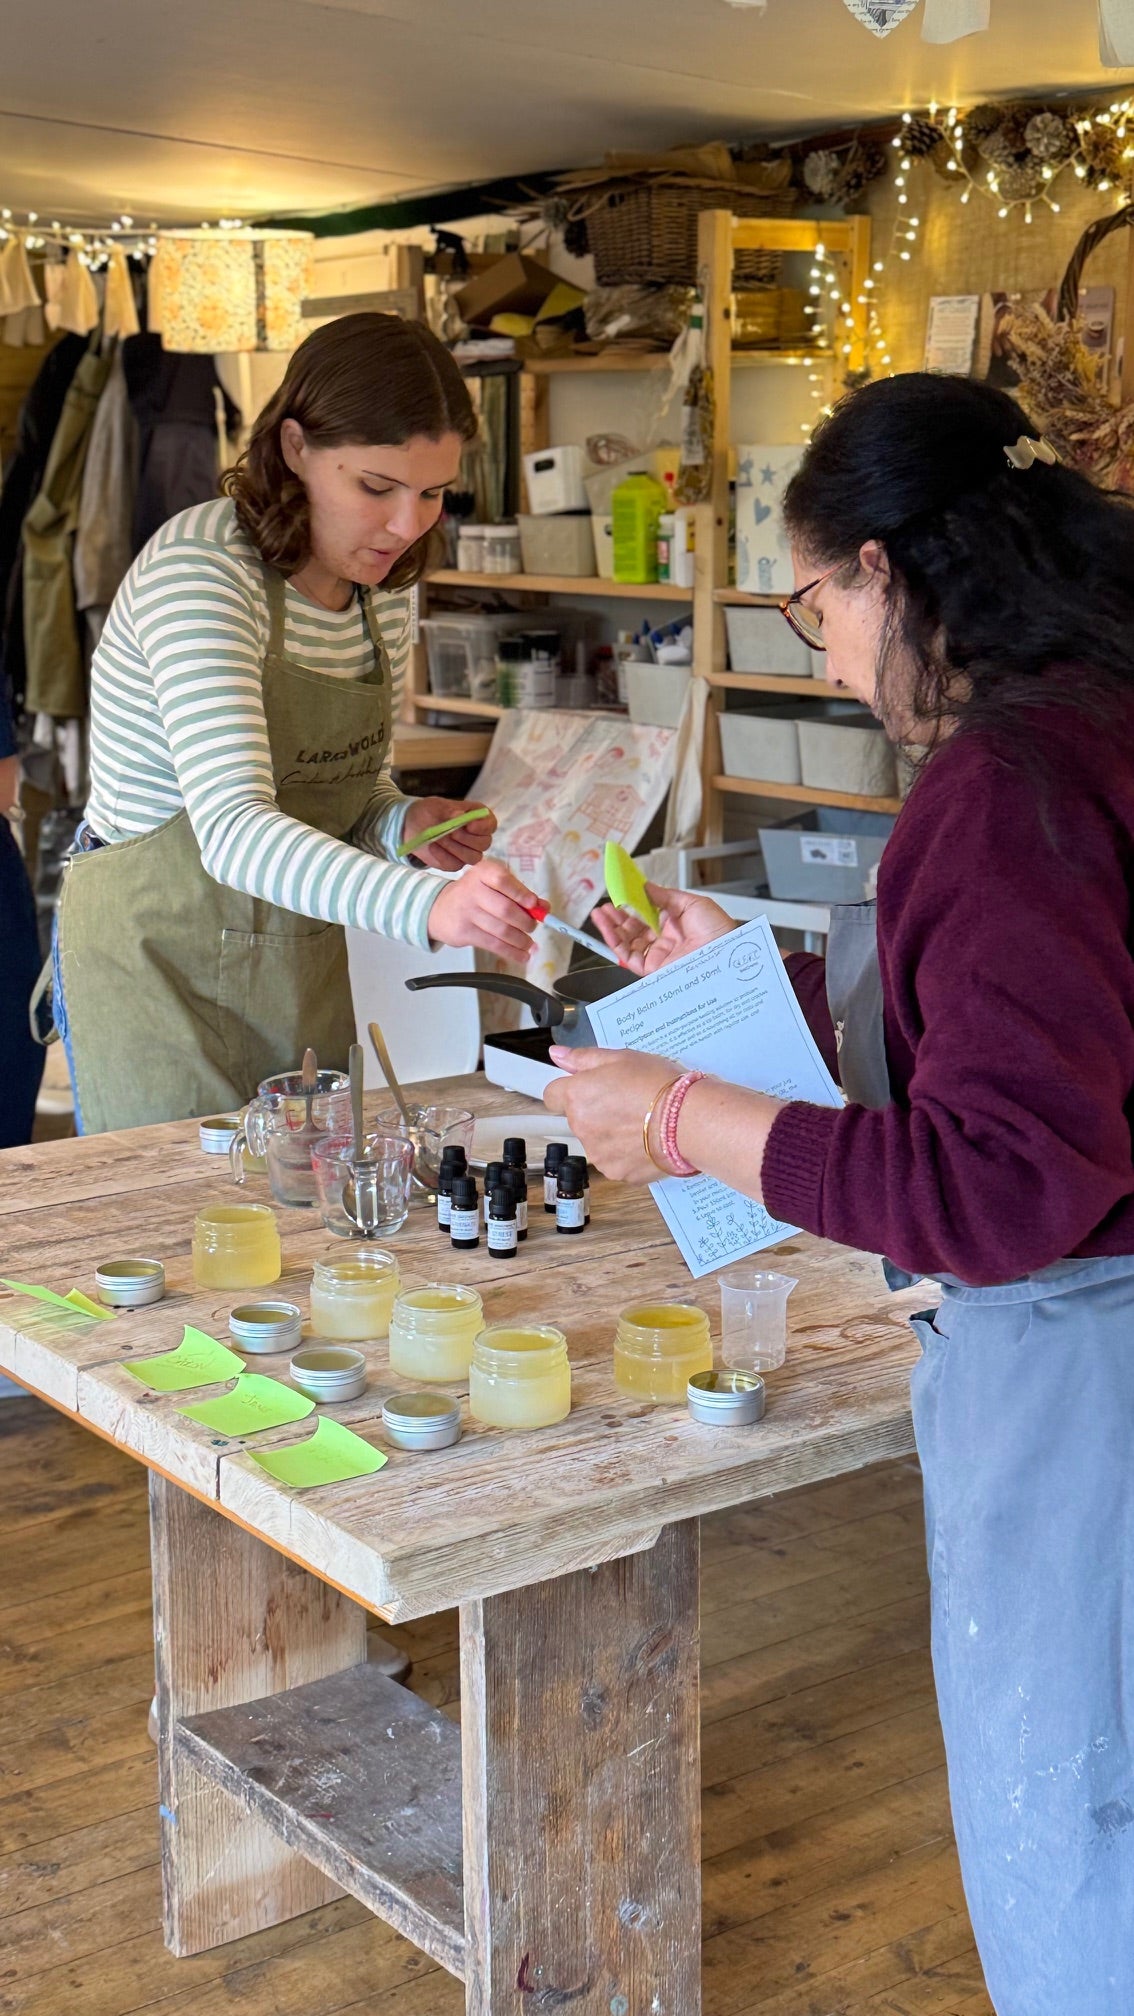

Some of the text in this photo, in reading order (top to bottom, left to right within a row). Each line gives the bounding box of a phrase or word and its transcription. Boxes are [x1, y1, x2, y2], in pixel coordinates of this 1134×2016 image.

[616, 1009, 636, 1026] Body
[636, 1000, 658, 1014] Balm
[658, 985, 684, 1004] 150ml
[684, 974, 700, 990] and
[701, 964, 722, 982] 50ml
[620, 1020, 644, 1038] Recipe
